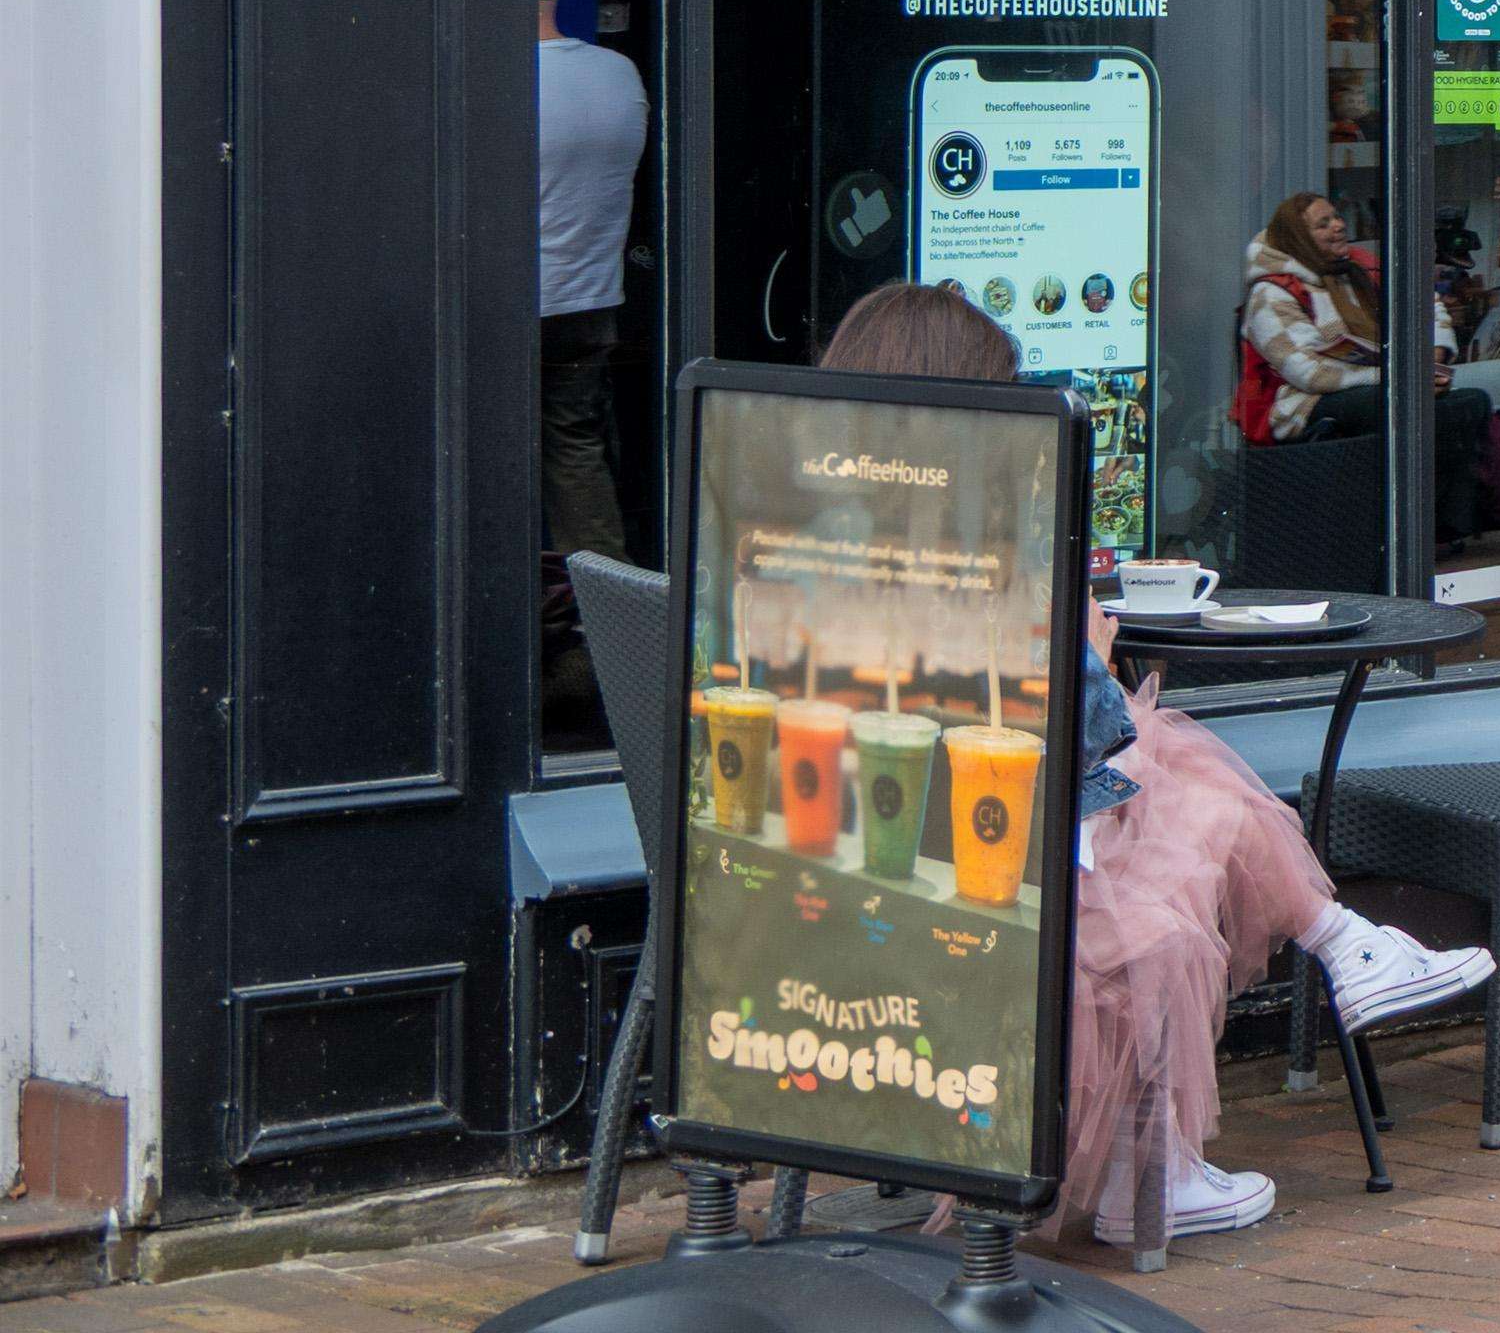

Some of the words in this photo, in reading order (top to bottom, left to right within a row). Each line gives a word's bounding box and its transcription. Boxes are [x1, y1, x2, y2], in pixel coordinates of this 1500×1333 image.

[1462, 8, 1487, 21] GOOD
[1486, 4, 1498, 16] TO
[935, 71, 960, 81] 20:09
[1434, 76, 1454, 84] OOD
[1456, 76, 1489, 85] HYGIENE
[985, 101, 1091, 112] thecoffeehouseonline
[1107, 139, 1125, 149] 998
[942, 148, 973, 171] CH
[1052, 153, 1083, 162] Followers
[1100, 152, 1131, 162] Following
[1041, 175, 1071, 185] Follow
[931, 210, 950, 220] The
[952, 210, 985, 220] Coffee
[988, 209, 1020, 219] House
[993, 236, 1015, 245] North
[1025, 320, 1072, 331] CUSTOMERS
[1085, 319, 1110, 329] RETAIL
[979, 805, 1002, 825] CH
[932, 928, 950, 942] The
[951, 931, 981, 946] Yellow
[777, 978, 921, 1030] SIGNATURE
[707, 1010, 998, 1109] Smoothies
